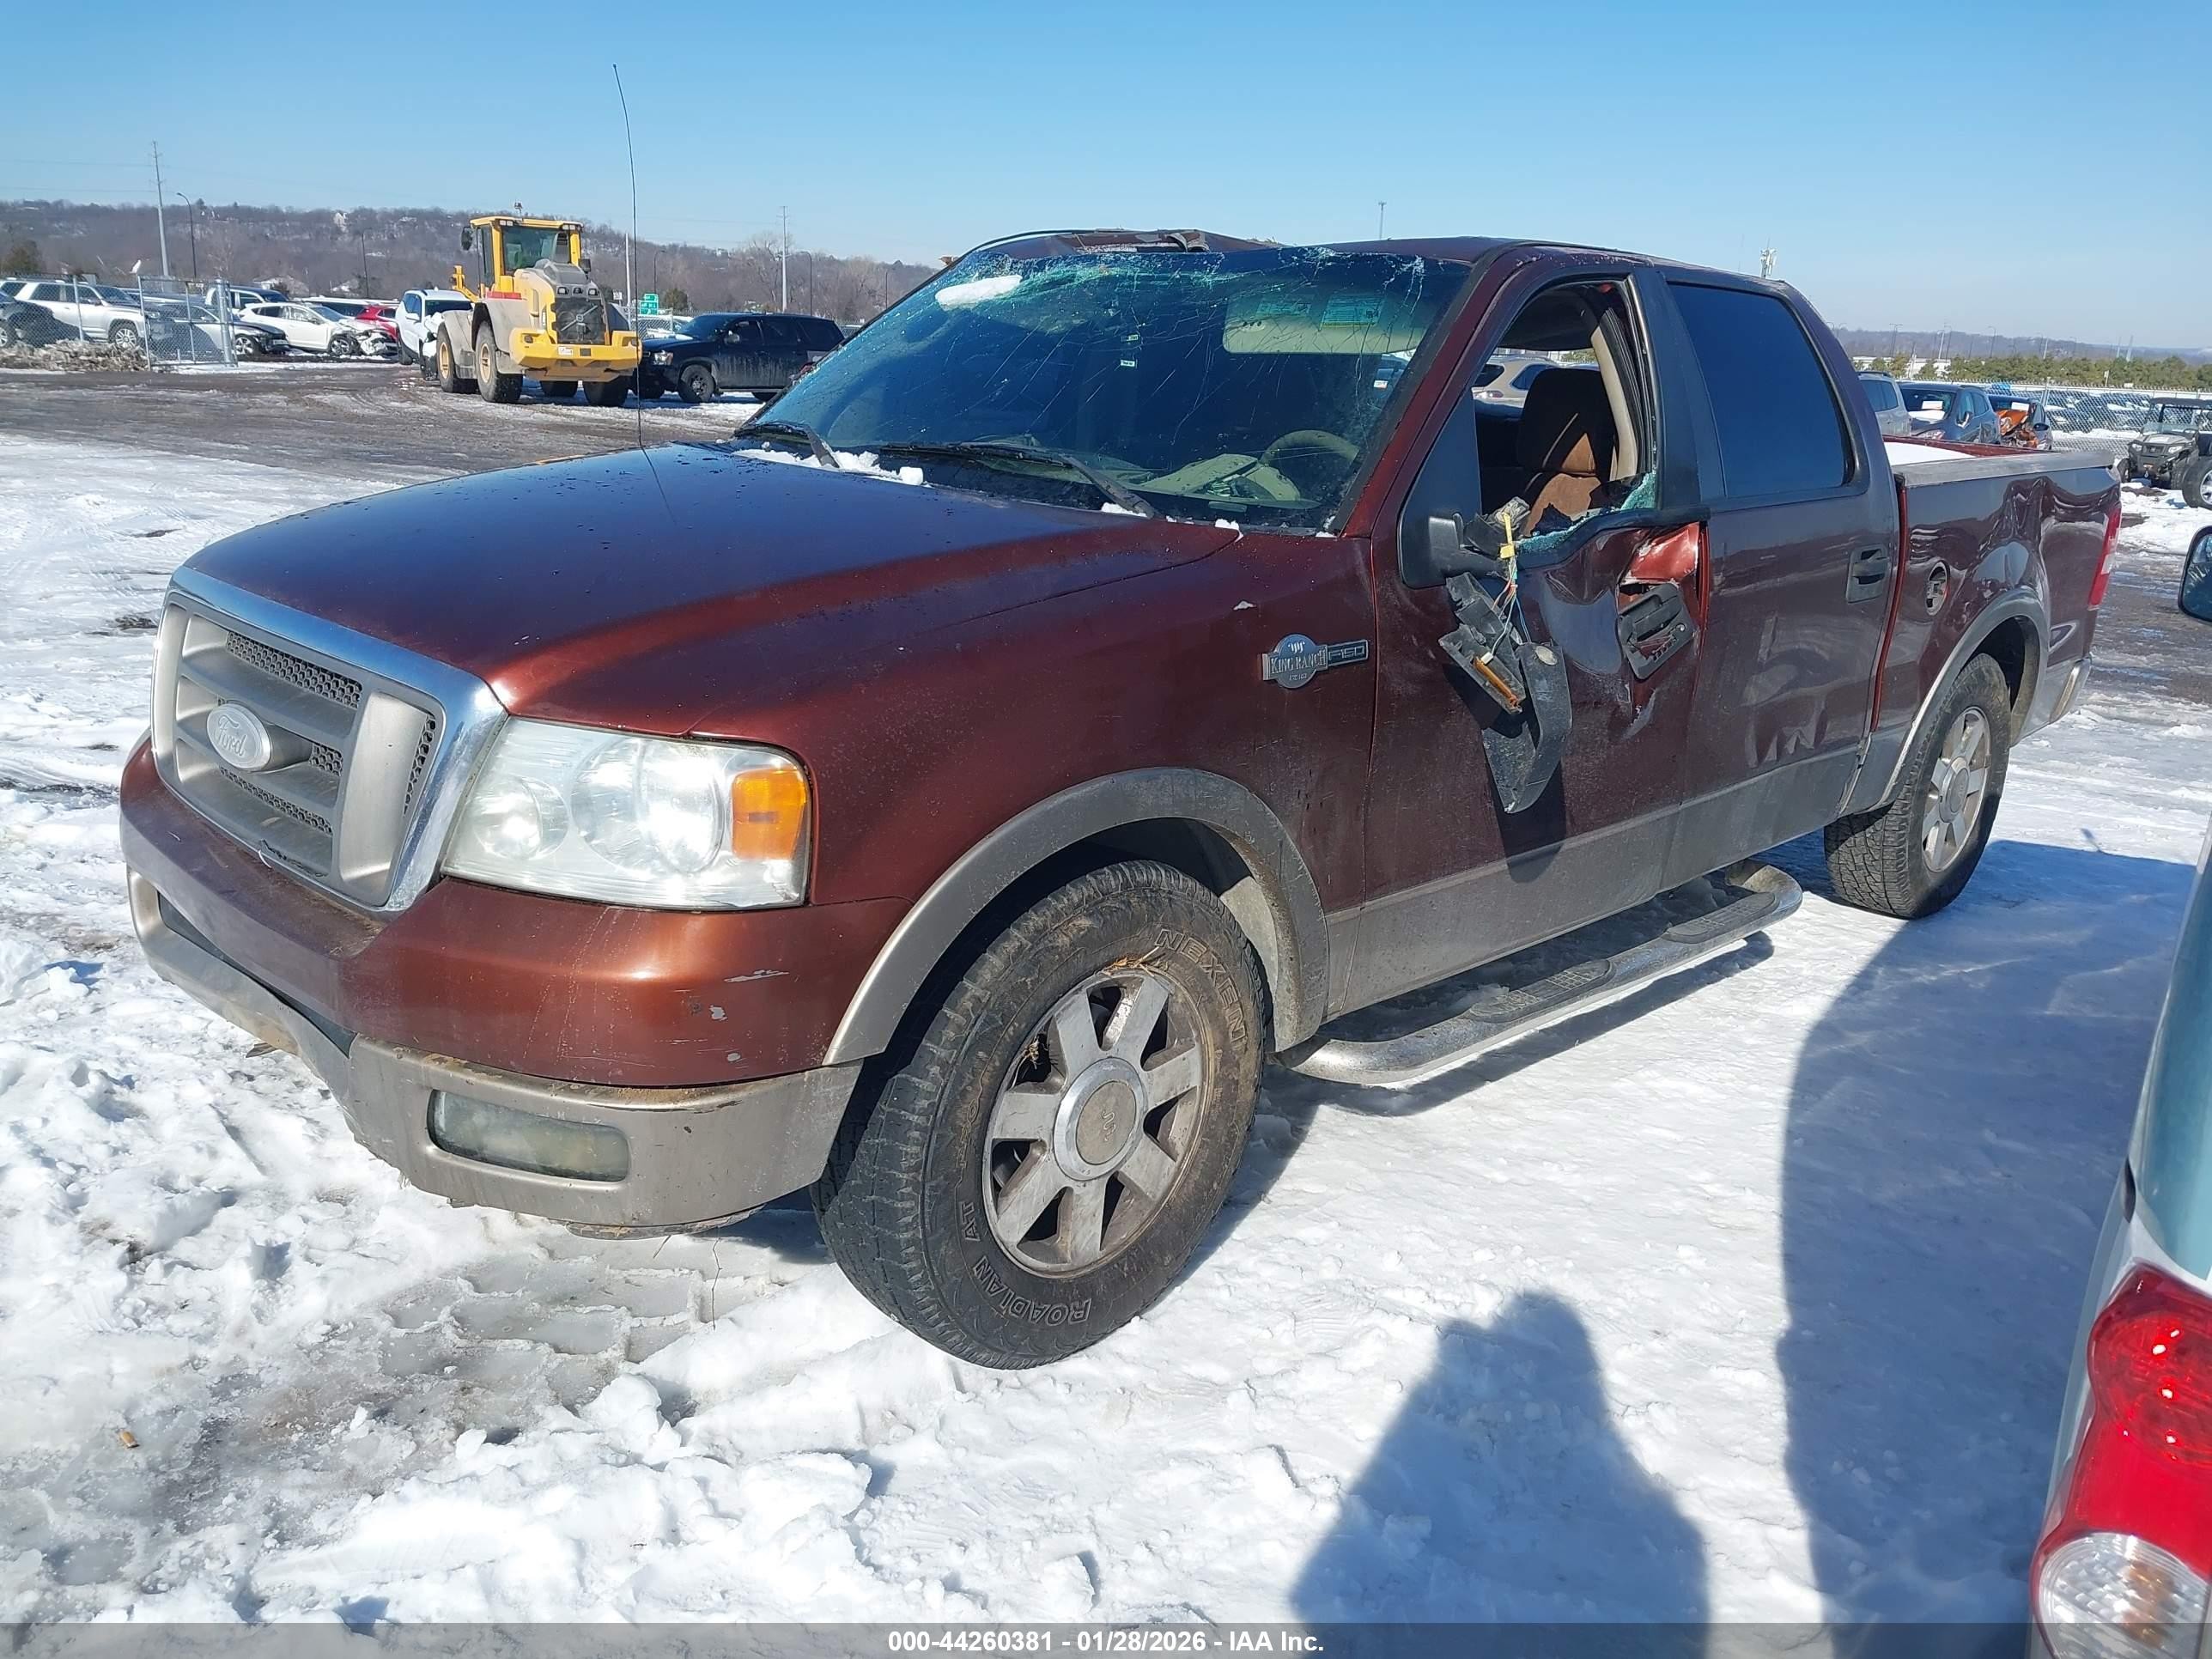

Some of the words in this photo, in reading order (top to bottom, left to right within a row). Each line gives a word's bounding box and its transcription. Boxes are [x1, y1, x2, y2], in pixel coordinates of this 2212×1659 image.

[1271, 657, 1294, 674] KING
[1296, 649, 1326, 670] RANCH
[216, 714, 246, 757] Ford
[1154, 928, 1249, 1044] NEXEN
[960, 1200, 981, 1243] AT
[972, 1255, 1092, 1327] ROADIAN
